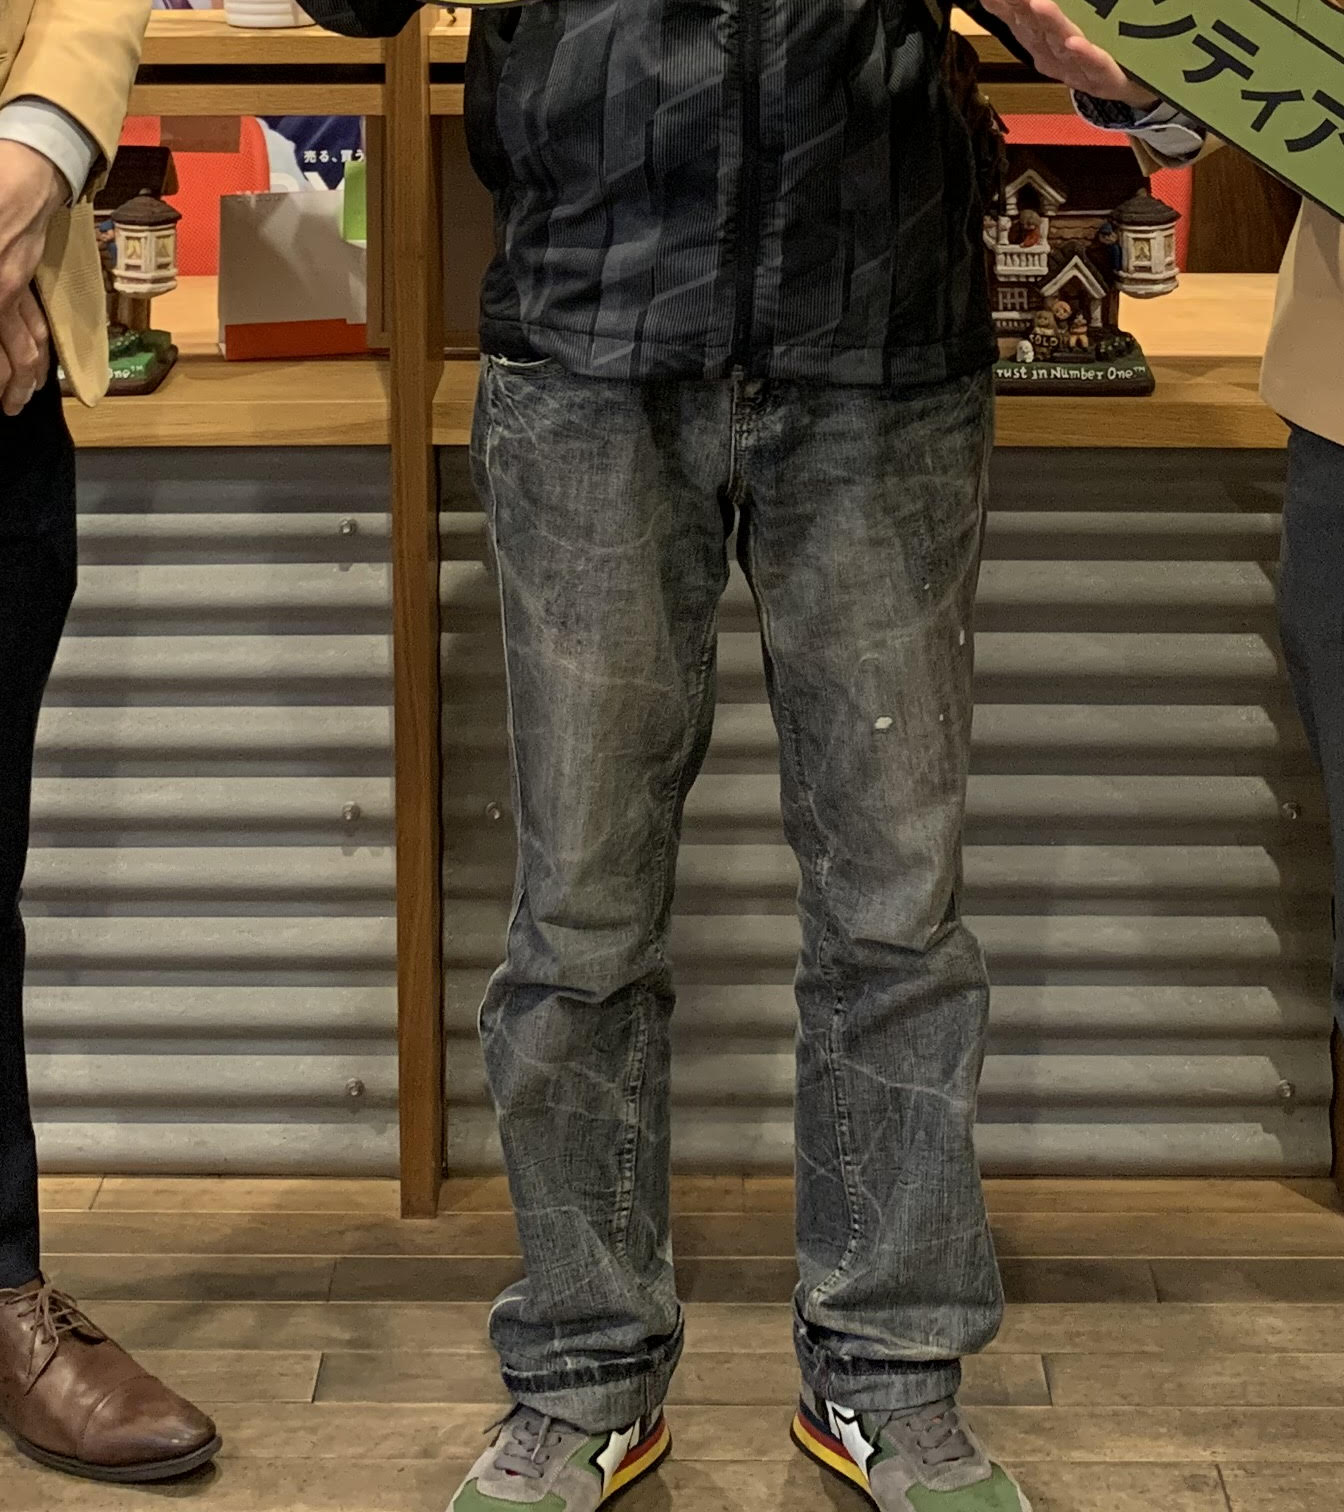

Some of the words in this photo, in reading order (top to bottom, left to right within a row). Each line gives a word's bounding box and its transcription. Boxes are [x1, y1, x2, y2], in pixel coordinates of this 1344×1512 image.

[996, 366, 1027, 379] rust
[1031, 365, 1048, 380] in
[1050, 366, 1104, 381] Number
